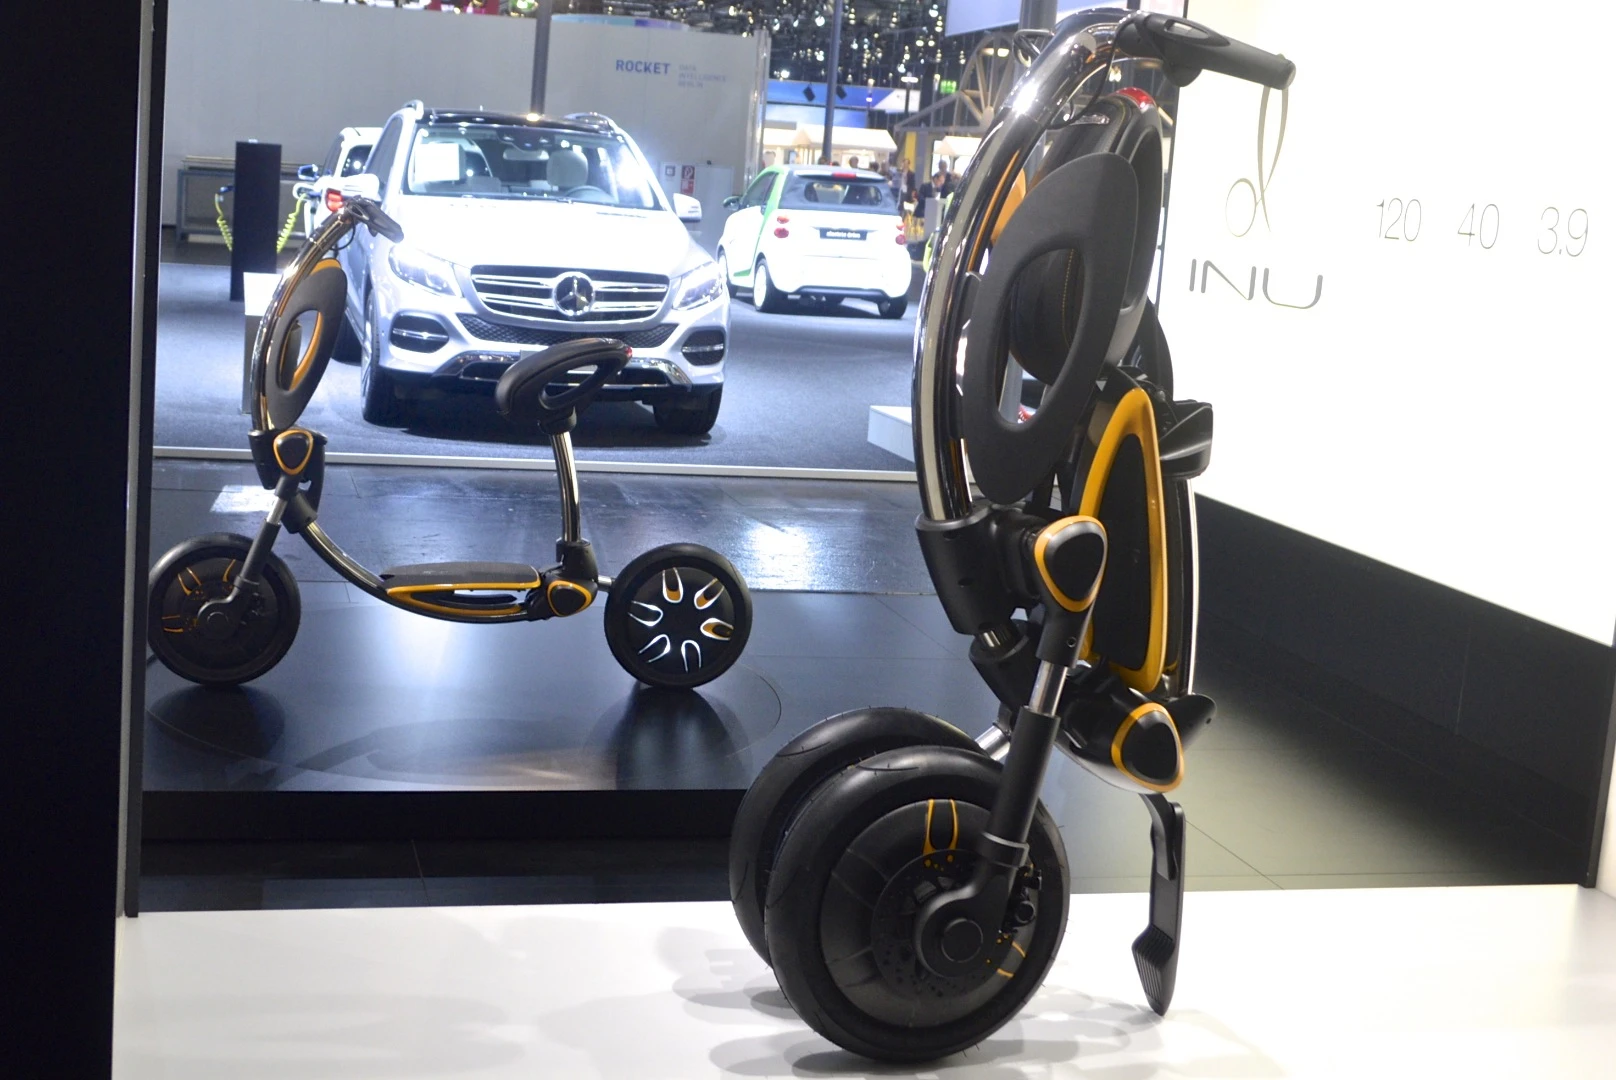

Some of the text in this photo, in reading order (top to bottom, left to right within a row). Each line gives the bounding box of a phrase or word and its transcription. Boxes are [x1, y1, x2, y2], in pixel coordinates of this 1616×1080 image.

[615, 59, 671, 75] ROCKET
[1376, 198, 1588, 257] 120 40 3.9
[1189, 258, 1323, 309] INU
